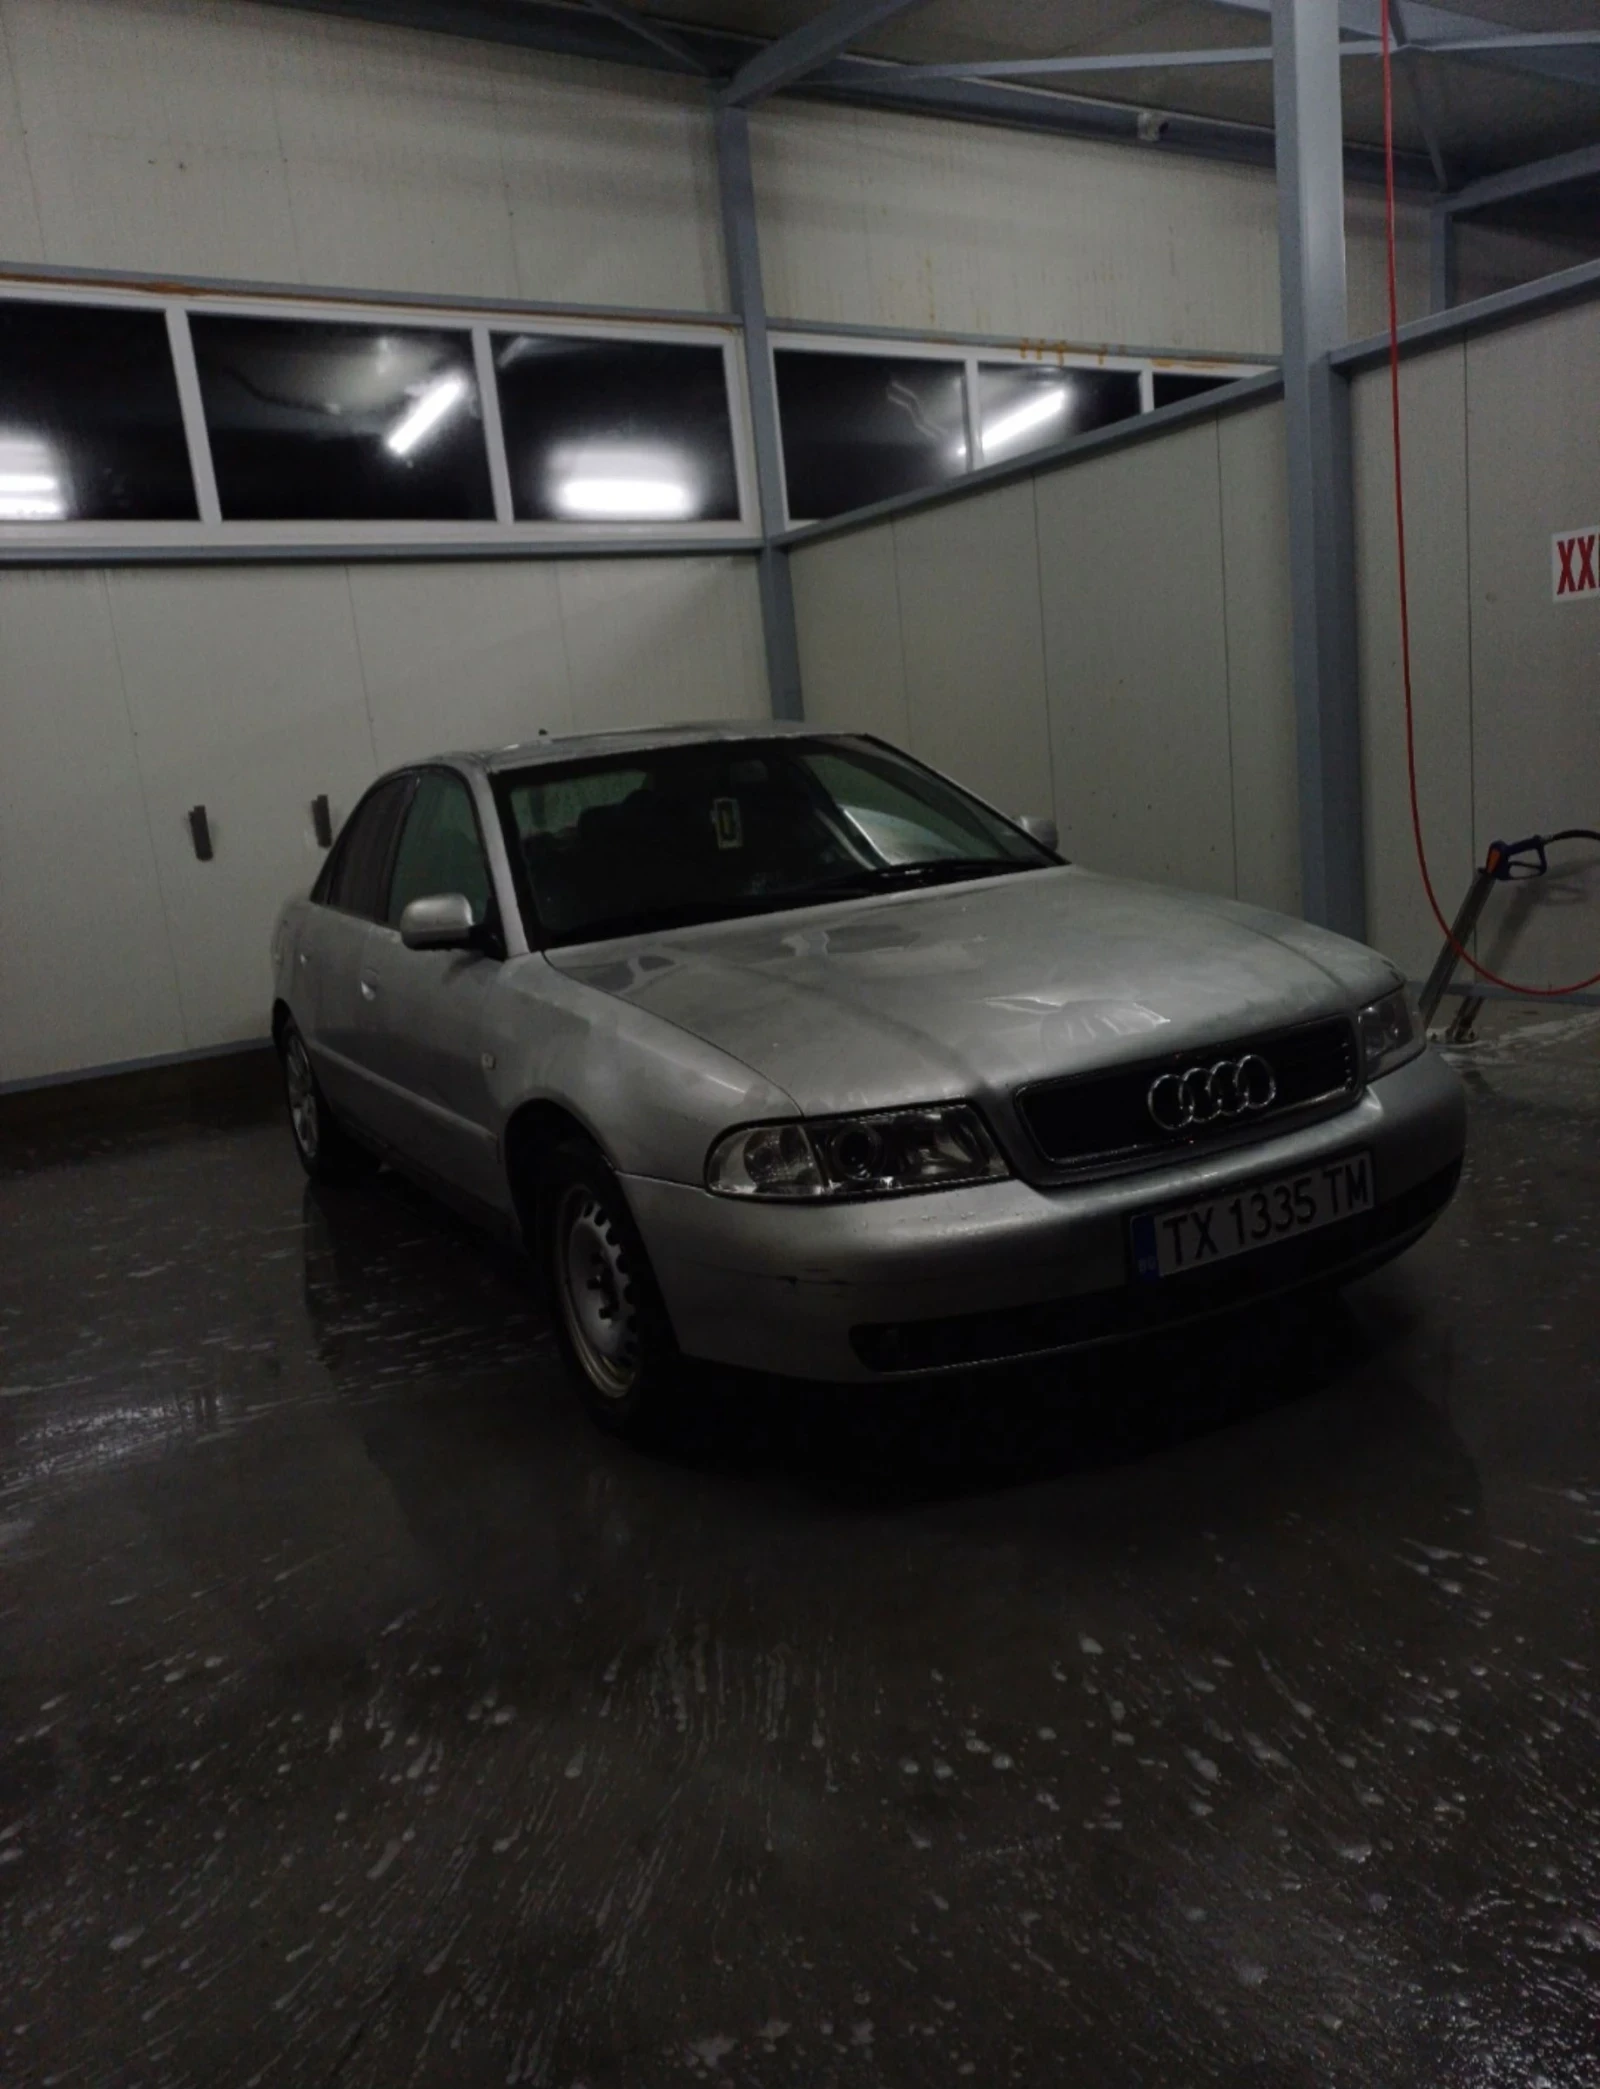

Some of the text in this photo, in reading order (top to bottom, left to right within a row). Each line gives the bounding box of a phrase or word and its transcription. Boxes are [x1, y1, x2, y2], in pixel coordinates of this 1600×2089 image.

[1557, 533, 1600, 595] XX
[1163, 1158, 1369, 1266] TX 1335 TM
